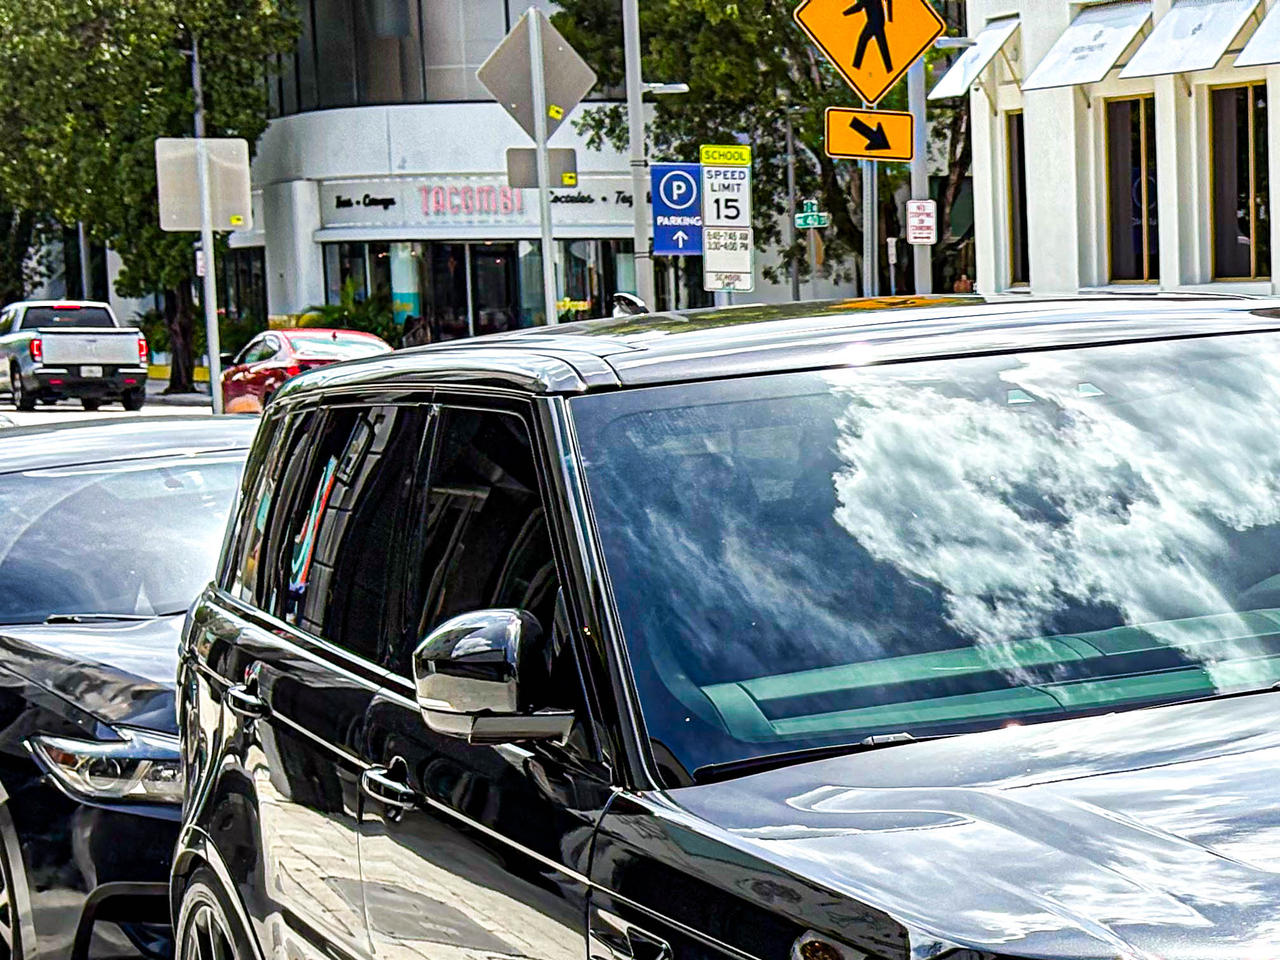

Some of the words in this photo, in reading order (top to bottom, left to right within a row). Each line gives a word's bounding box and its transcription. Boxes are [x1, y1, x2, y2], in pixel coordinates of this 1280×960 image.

[704, 150, 746, 161] SCHOOL
[706, 170, 746, 180] SPEED
[672, 180, 687, 201] P
[710, 183, 742, 193] LIMIT
[713, 198, 740, 220] 15
[656, 216, 703, 226] PARKING
